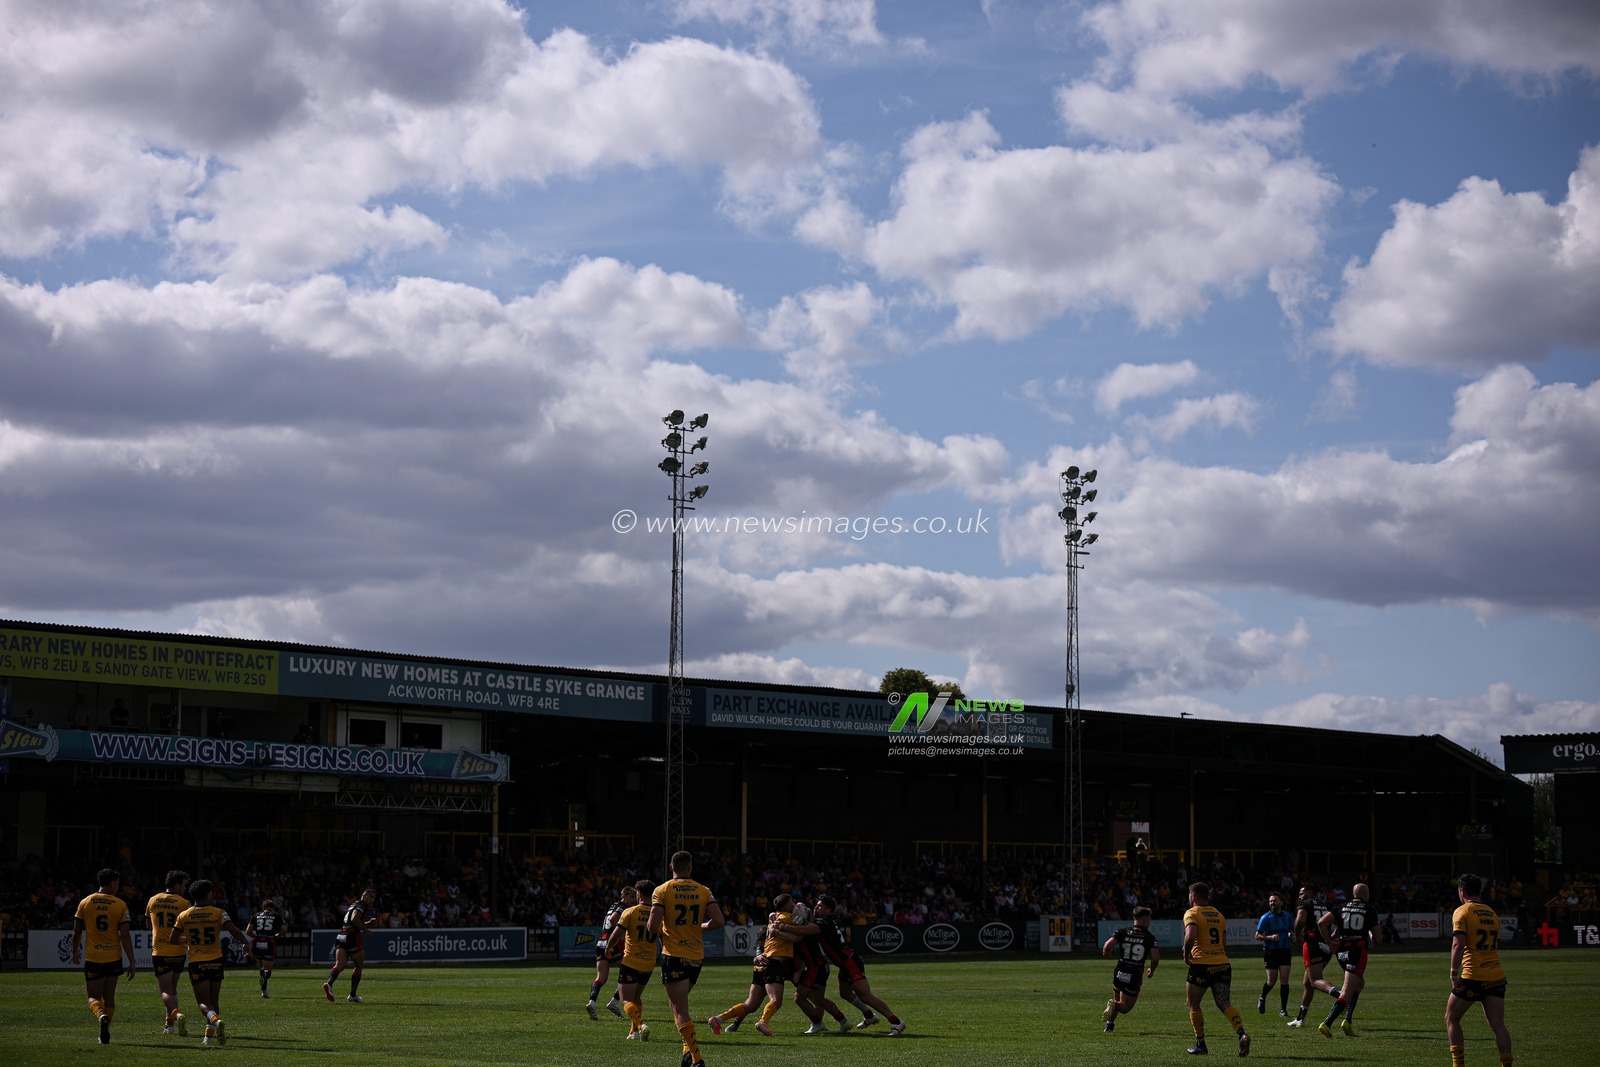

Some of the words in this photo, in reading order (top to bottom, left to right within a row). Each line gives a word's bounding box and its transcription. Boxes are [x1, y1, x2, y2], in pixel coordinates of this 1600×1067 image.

[0, 634, 42, 653] RARY
[48, 638, 86, 657] NEW
[92, 641, 147, 661] HOMES
[153, 646, 169, 662] IN
[174, 648, 274, 671] PONTEFRACT
[20, 656, 48, 670] WF8
[53, 659, 78, 672] 2EU
[82, 661, 91, 674] &
[95, 662, 138, 677] SANDY
[142, 665, 173, 680] GATE
[177, 667, 210, 684] VIEW,
[215, 670, 240, 684] WF8
[244, 673, 266, 686] 2SG
[289, 656, 356, 677] LUXURY
[362, 661, 399, 680] NEW
[404, 665, 459, 685] HOMES
[463, 671, 481, 686] AT
[486, 673, 541, 692] CASTLE
[545, 678, 582, 696] SYKE
[586, 682, 645, 701] GRANGE
[388, 684, 462, 702] ACKWORTH
[466, 690, 503, 707] ROAD,
[507, 693, 534, 708] WF8
[537, 697, 560, 711] 4RE
[713, 693, 752, 713] PART
[757, 697, 840, 719] EXCHANGE
[712, 713, 736, 723] DAVID
[736, 714, 765, 725] WILSON
[766, 716, 793, 727] HOMES
[794, 717, 820, 729] COULD
[821, 720, 831, 729] BE
[832, 721, 853, 730] YOUR
[1018, 726, 1034, 734] CODE
[1035, 727, 1047, 735] FOR
[1026, 735, 1050, 744] DETAILS
[90, 733, 425, 776] WWW.SIGNS-DESIGNS.CO.UK
[96, 914, 108, 931] 6
[156, 911, 179, 928] 13
[674, 904, 700, 925] 21
[1341, 911, 1365, 931] 10
[256, 918, 274, 931] 35
[1411, 919, 1437, 929] SSS
[188, 926, 217, 946] 35
[735, 933, 748, 950] CS
[870, 930, 900, 942] McTigue
[927, 929, 956, 940] McTigue
[983, 928, 1011, 939] McTigue
[1209, 927, 1220, 945] 9
[1476, 929, 1498, 950] 27
[388, 934, 508, 957] ajglassfibre.co.uk
[1121, 943, 1146, 961] 19
